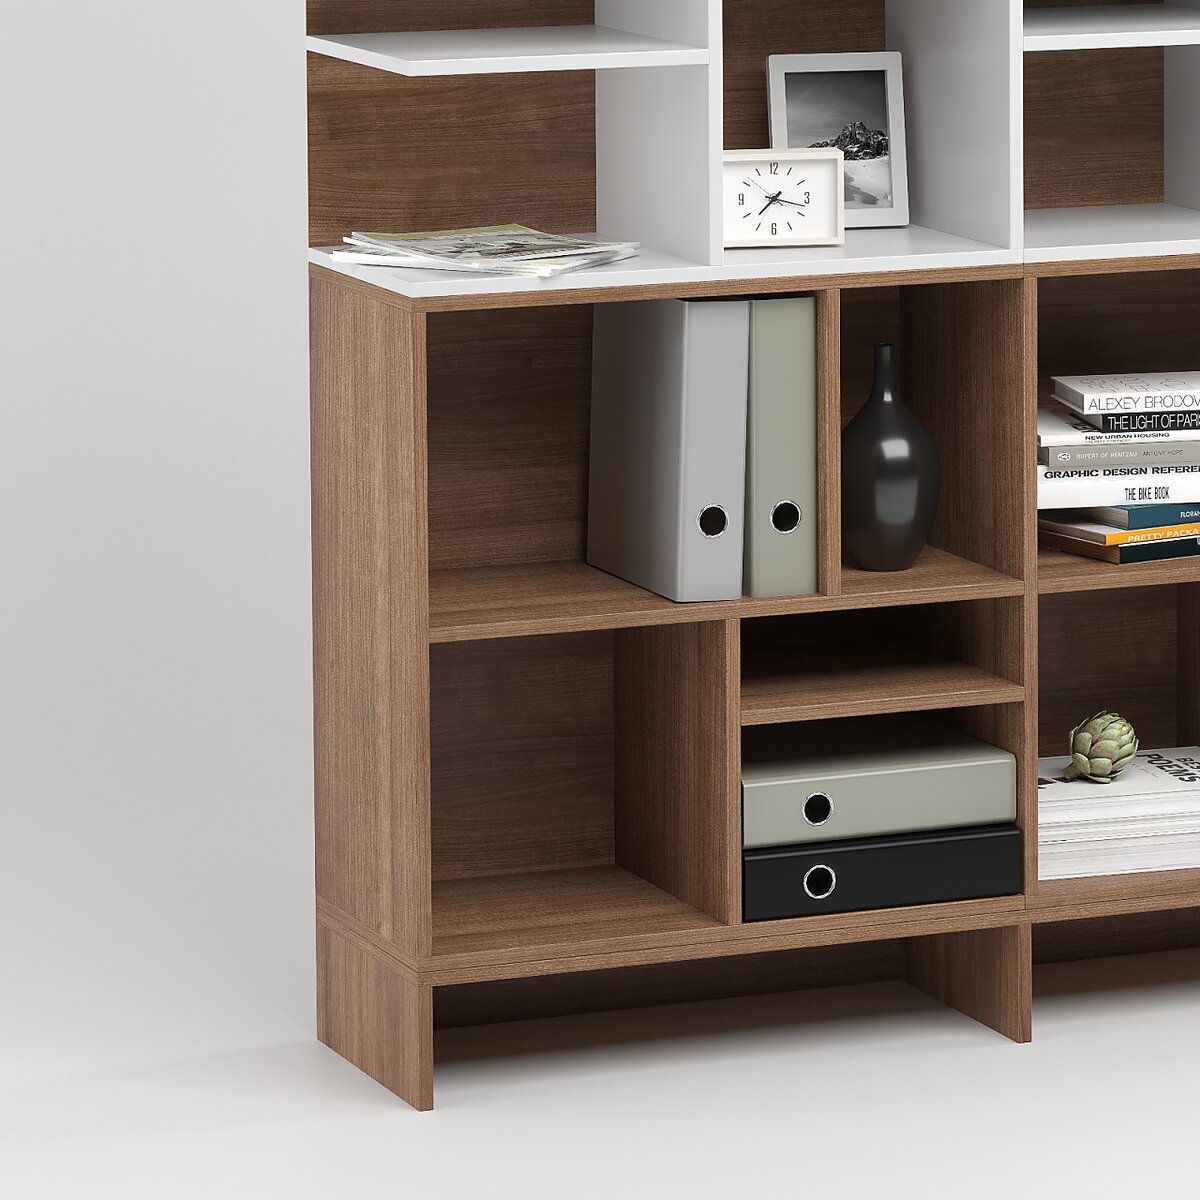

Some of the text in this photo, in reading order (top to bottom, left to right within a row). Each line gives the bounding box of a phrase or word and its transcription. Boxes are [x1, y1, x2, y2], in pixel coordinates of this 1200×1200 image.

[769, 162, 779, 175] 12
[738, 193, 744, 205] 9
[804, 191, 810, 204] 3
[771, 222, 777, 235] 6
[1088, 396, 1141, 411] ALEXEY
[1107, 415, 1129, 431] THE
[1130, 414, 1160, 430] LIGHT
[1160, 413, 1176, 429] OF
[1110, 451, 1138, 459] HENTZAU
[1044, 468, 1099, 480] GRAPHIC
[1102, 466, 1148, 477] DESIGN
[1125, 486, 1170, 501] THE BIKE BOOK
[1127, 531, 1166, 543] PRETTY
